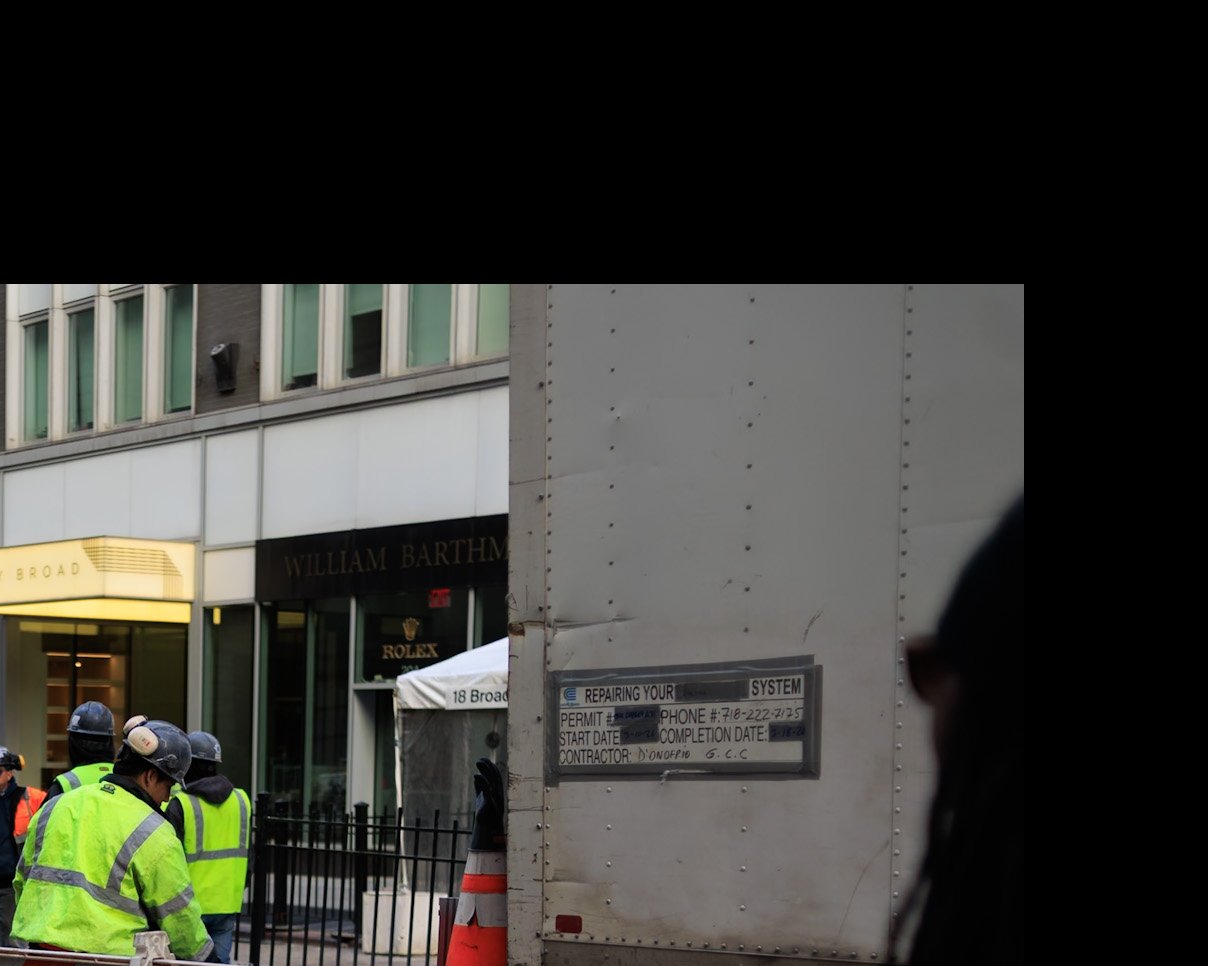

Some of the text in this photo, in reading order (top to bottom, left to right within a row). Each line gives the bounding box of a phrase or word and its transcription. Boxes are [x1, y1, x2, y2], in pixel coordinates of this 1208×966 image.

[16, 562, 80, 581] BROAD
[284, 547, 387, 578] WILLIAM
[382, 643, 440, 660] ROLEX
[453, 689, 466, 703] 18
[585, 678, 801, 703] REPAIRING YOUR SYSTEM
[561, 711, 603, 727] PERMIT
[660, 708, 706, 725] PHONE
[560, 730, 591, 746] START
[660, 726, 731, 744] COMPLETION
[735, 725, 767, 742] DATE:
[560, 748, 632, 764] CONTRACTOR:
